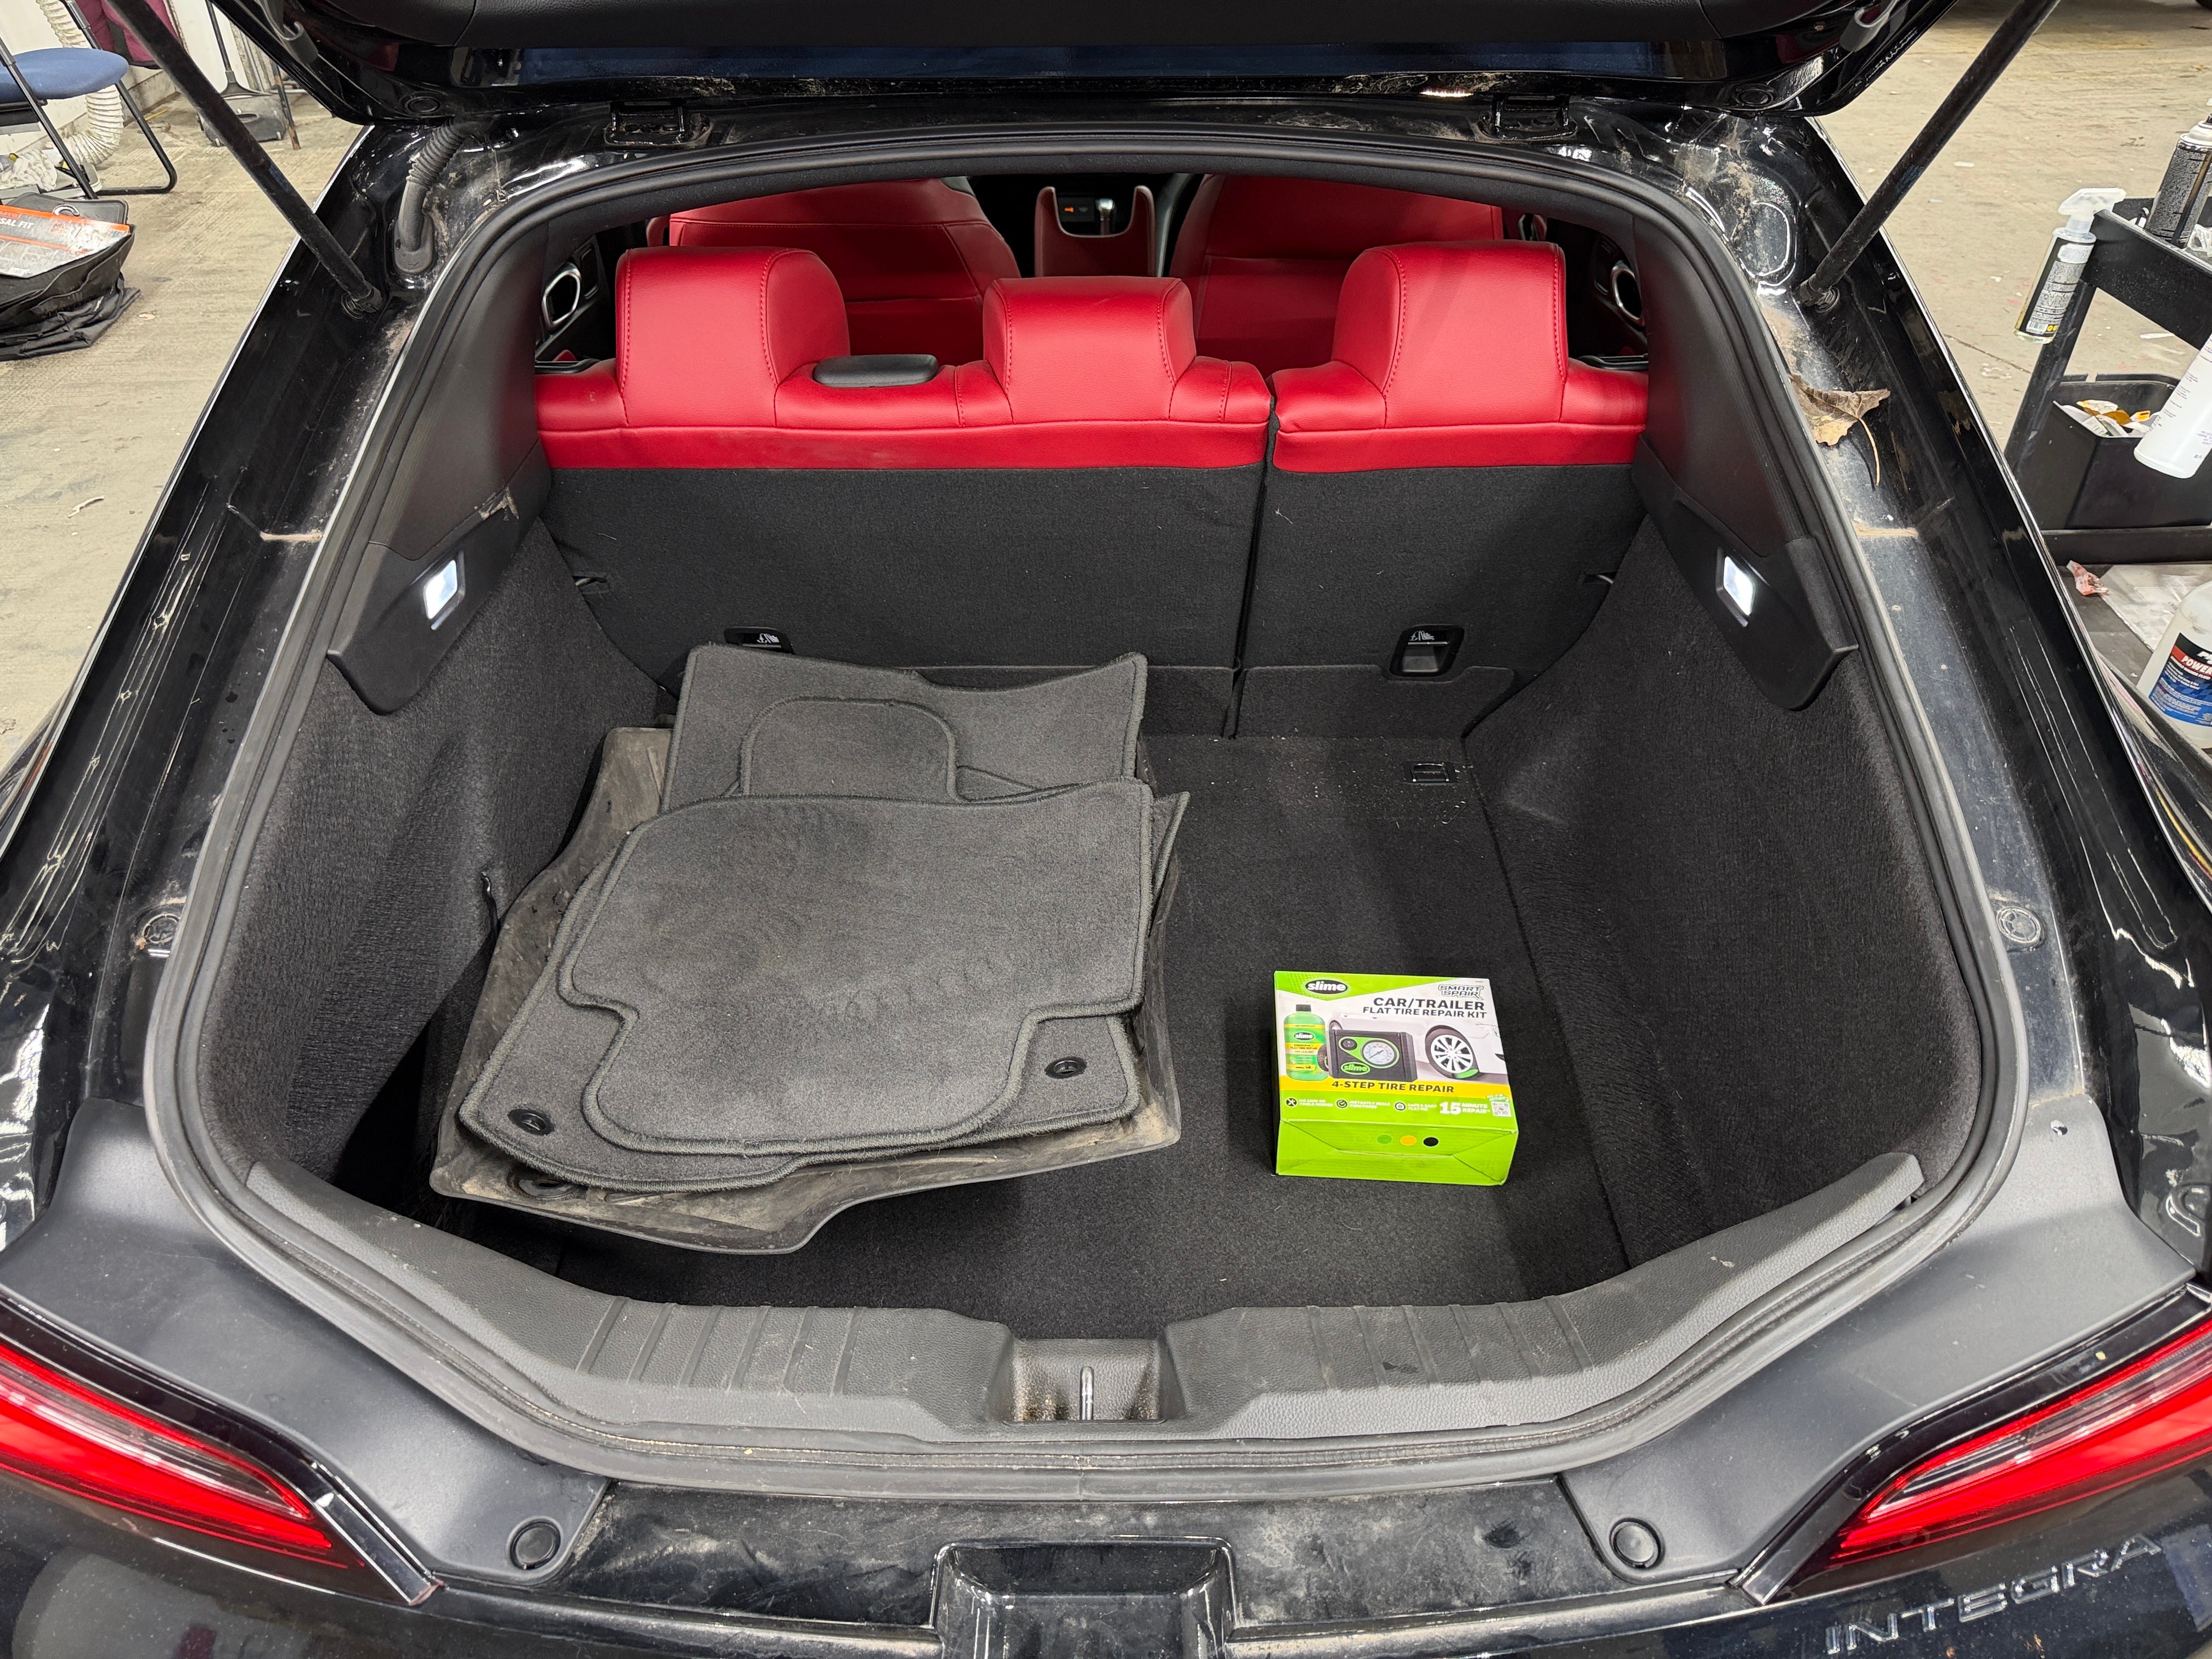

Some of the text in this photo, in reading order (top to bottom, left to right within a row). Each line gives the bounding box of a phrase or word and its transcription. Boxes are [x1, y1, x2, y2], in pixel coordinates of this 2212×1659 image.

[0, 217, 35, 229] SAL FIT
[1307, 981, 1346, 991] slime
[1443, 990, 1482, 999] SPAIR
[1373, 997, 1485, 1011] CAR/TRAILER
[1423, 1009, 1464, 1018] REPAIR
[1331, 1081, 1454, 1093] 4-STEP TIRE REPAIR
[1440, 1102, 1462, 1115] 15
[1825, 1534, 2162, 1655] INTEGRA
